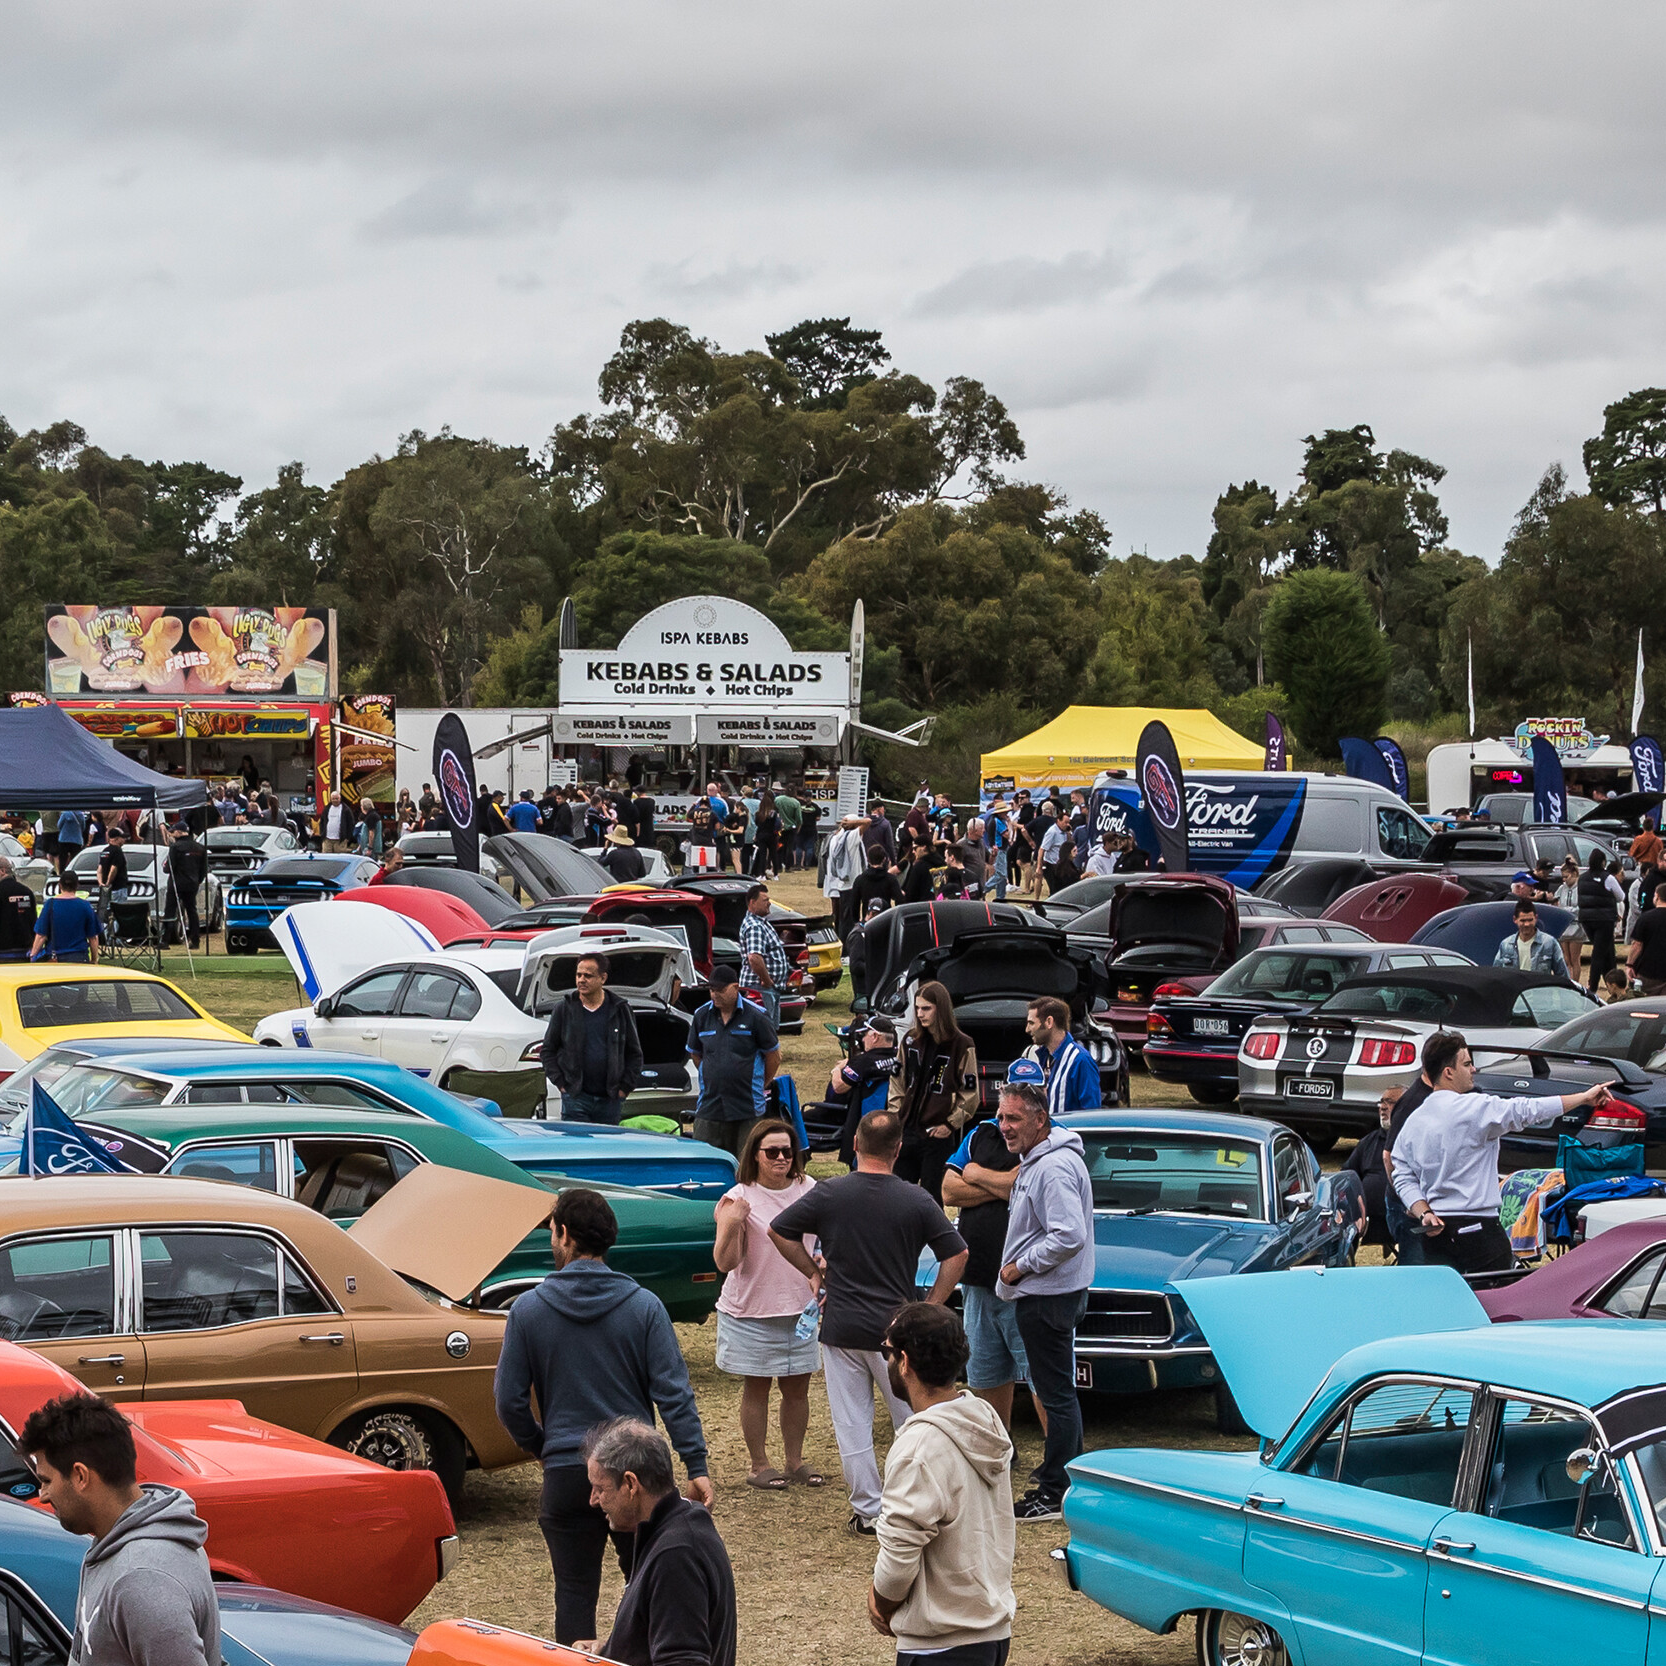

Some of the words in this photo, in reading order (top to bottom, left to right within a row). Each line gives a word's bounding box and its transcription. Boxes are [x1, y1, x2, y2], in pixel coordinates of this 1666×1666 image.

[114, 614, 144, 637] PUGS
[261, 618, 288, 648] PUGS
[660, 632, 691, 645] ISPA
[697, 632, 749, 645] KEBABS
[164, 651, 211, 672] FRIES
[587, 661, 689, 682] KEBABS
[696, 663, 713, 682] &
[720, 663, 822, 683] SALADS
[614, 682, 646, 695] Cold
[648, 682, 696, 695] Drinks
[725, 684, 751, 696] Hot
[753, 684, 794, 698] Chips
[208, 713, 248, 734] HOT
[246, 718, 307, 733] CHIPS
[572, 720, 616, 730] KEBABS
[627, 721, 672, 730] SALADS
[717, 720, 761, 730] KEBABS
[772, 721, 817, 731] SALADS
[1517, 735, 1590, 750] DNUTS
[353, 759, 383, 768] JUMBO
[810, 789, 836, 799] HSP
[653, 804, 687, 815] LADS
[1096, 802, 1127, 833] Ford
[1221, 840, 1234, 848] Van
[1562, 1115, 1579, 1123] GT
